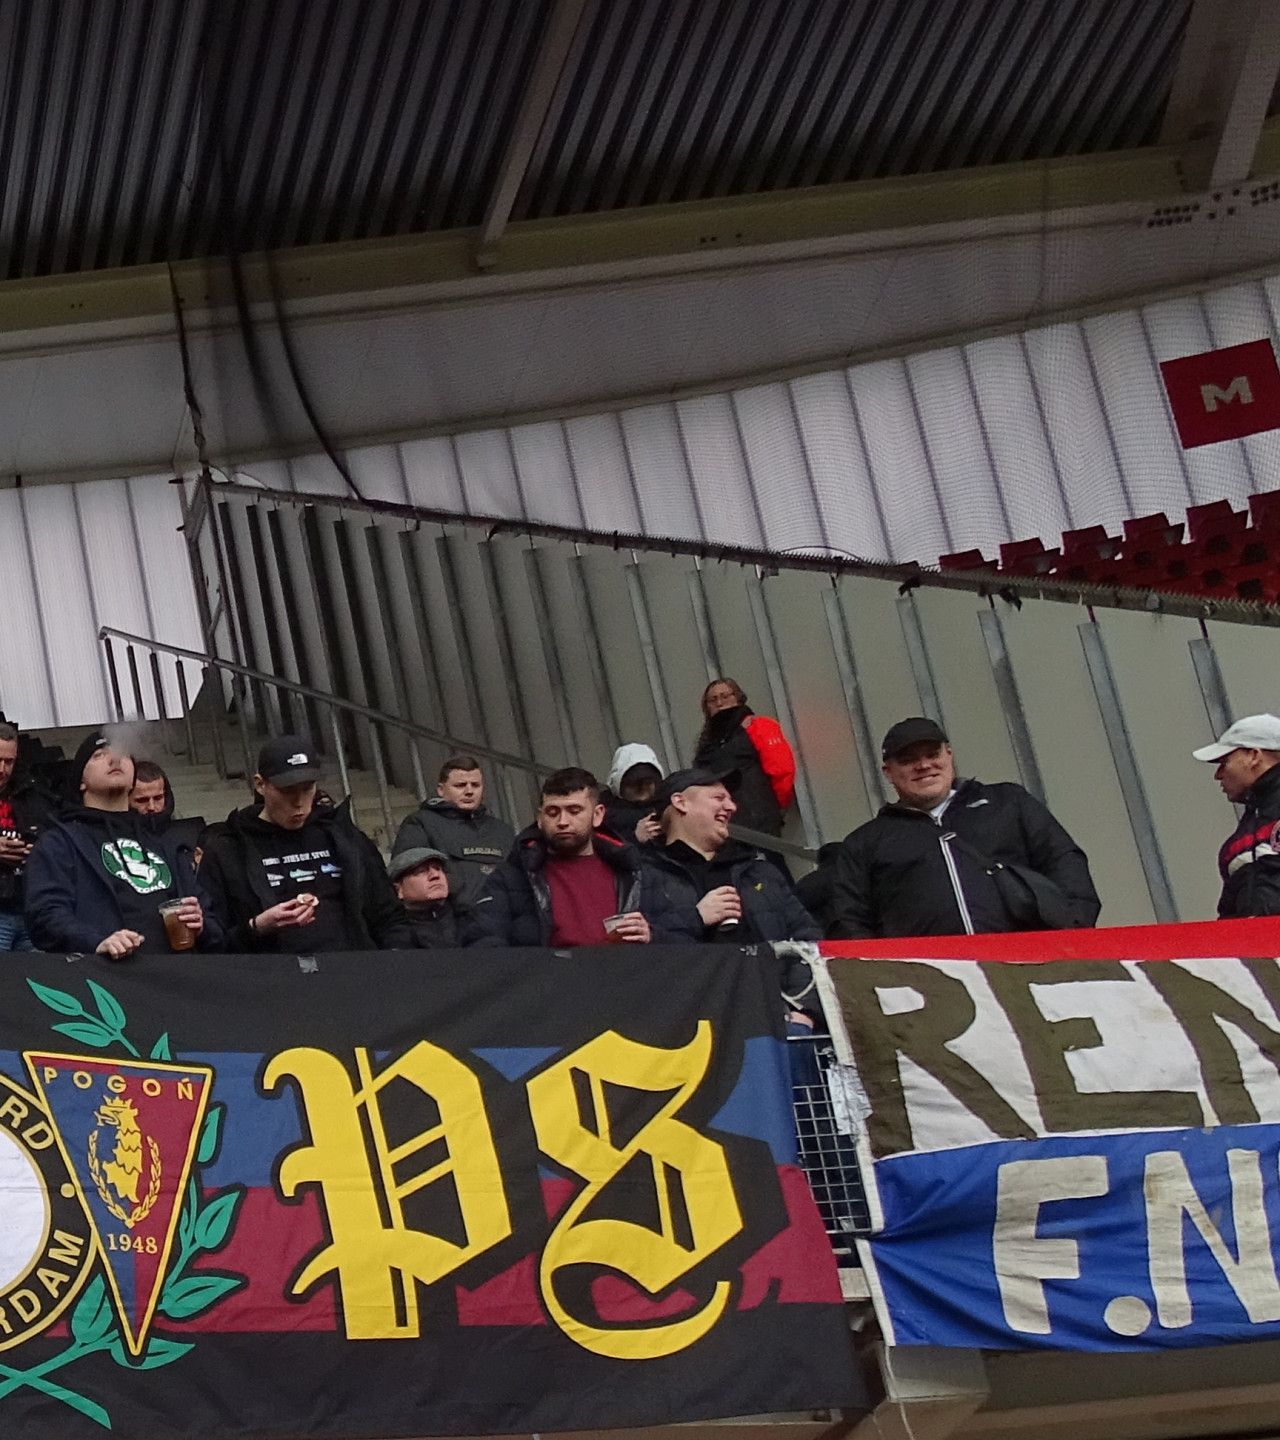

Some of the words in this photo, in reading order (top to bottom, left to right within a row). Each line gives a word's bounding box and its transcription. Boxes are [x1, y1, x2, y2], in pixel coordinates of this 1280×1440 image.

[1199, 376, 1254, 413] M
[42, 1064, 195, 1102] POGOŃ
[262, 1020, 744, 1360] PS
[106, 1232, 159, 1256] 1948
